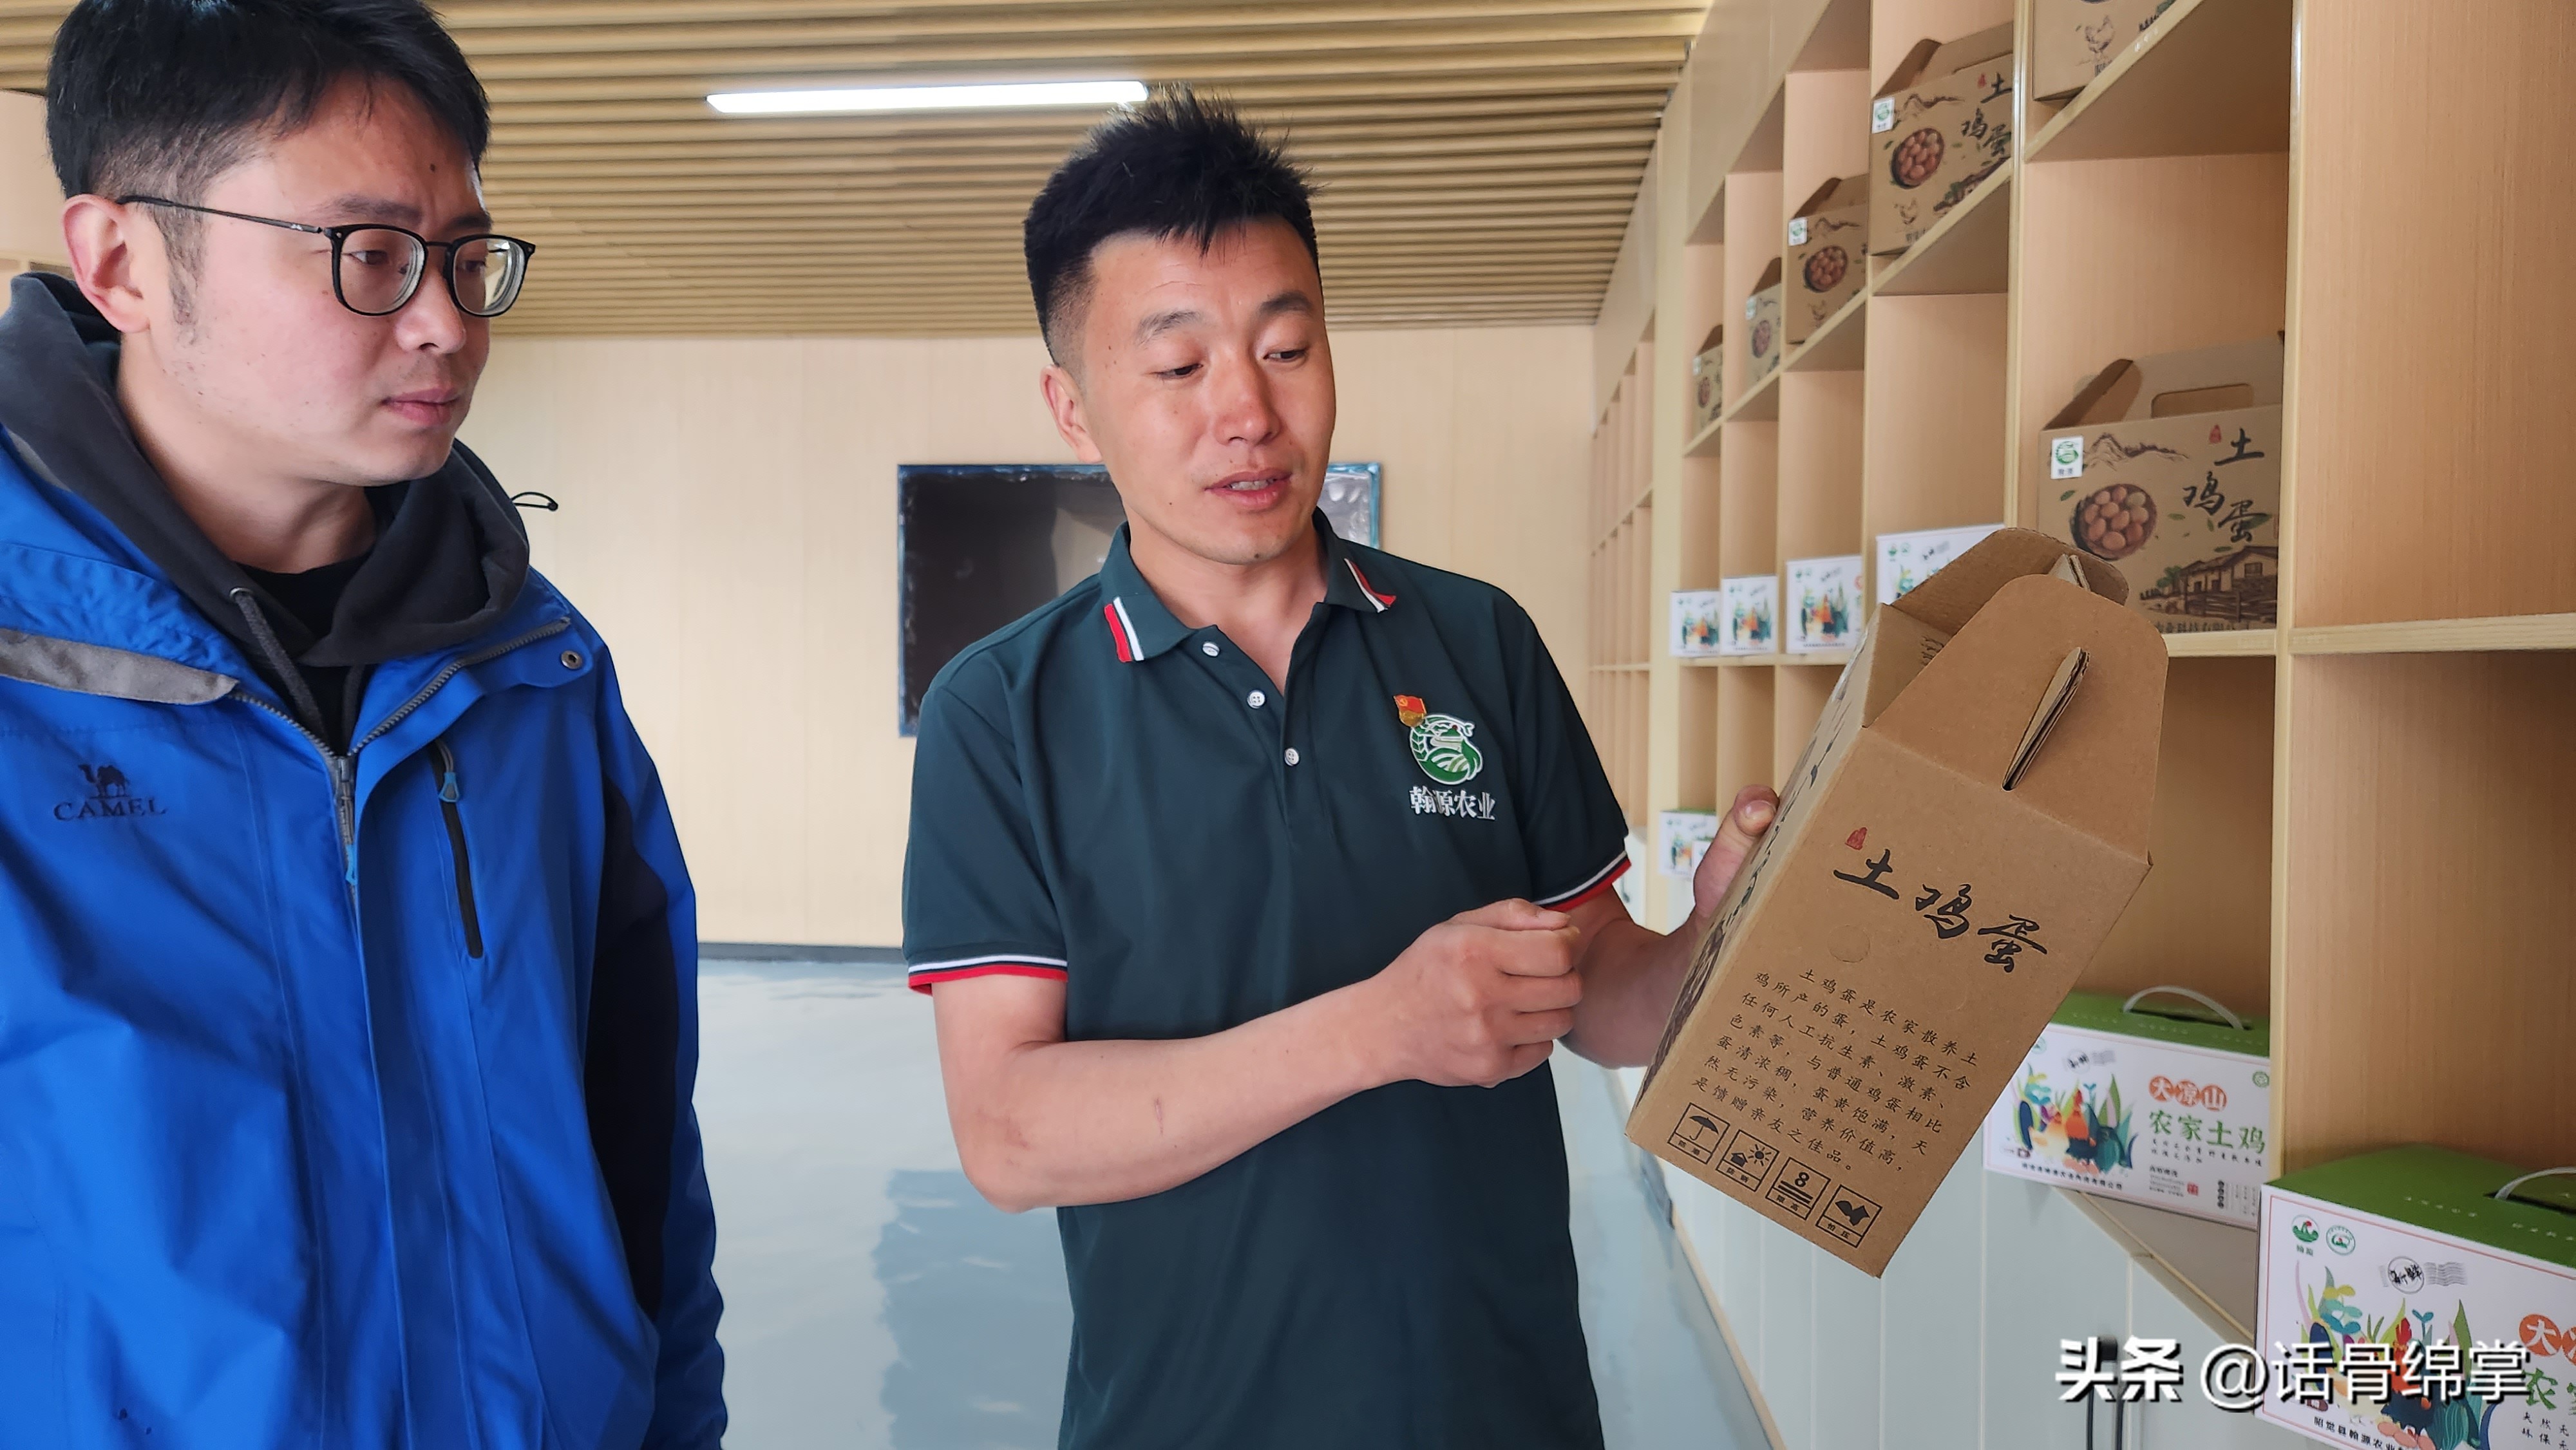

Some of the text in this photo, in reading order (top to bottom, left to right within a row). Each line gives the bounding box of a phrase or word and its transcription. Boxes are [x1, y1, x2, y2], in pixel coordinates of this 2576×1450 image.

[2183, 428, 2267, 543] 土鸡蛋
[53, 796, 168, 821] CAMEL
[1409, 786, 1495, 820] 翰源农业
[1833, 849, 2047, 973] 土鸡蛋
[1799, 969, 1977, 1066] 土鸡蛋是农家散养土
[2150, 1110, 2266, 1154] 农家土鸡
[2521, 1368, 2576, 1415] 农
